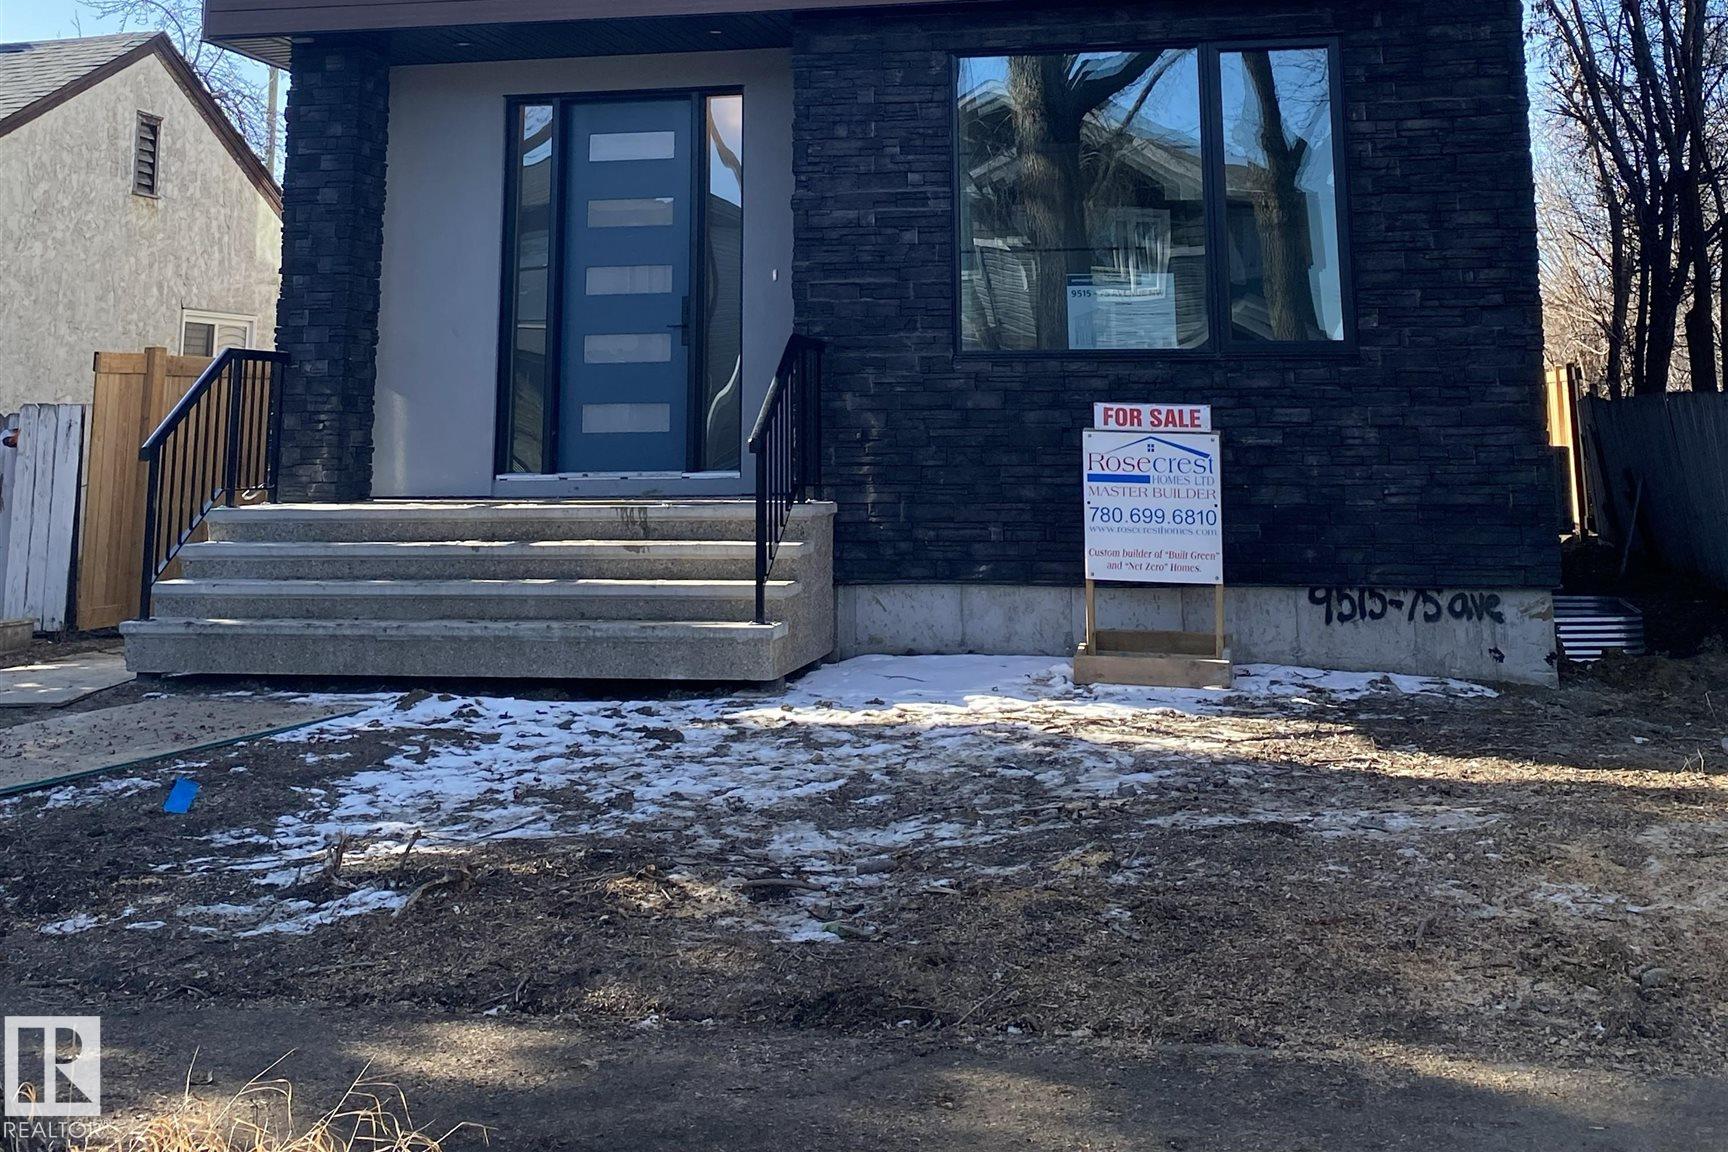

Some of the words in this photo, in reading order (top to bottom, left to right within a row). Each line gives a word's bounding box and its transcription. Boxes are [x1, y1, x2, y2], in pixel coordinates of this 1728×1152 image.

[1071, 289, 1092, 298] 9515
[1103, 406, 1142, 427] FOR
[1149, 407, 1202, 429] SALE
[1087, 452, 1214, 475] Rosecrest
[1152, 474, 1191, 486] HOMES
[1195, 475, 1215, 486] LTD
[1088, 485, 1149, 499] MASTER
[1152, 487, 1217, 500] BUILDER
[1089, 506, 1217, 526] 780.699.6810
[1088, 547, 1121, 558] Custom
[1122, 548, 1152, 558] builder
[1154, 549, 1164, 559] of
[1106, 561, 1123, 570] and
[1170, 563, 1202, 573] Homes.
